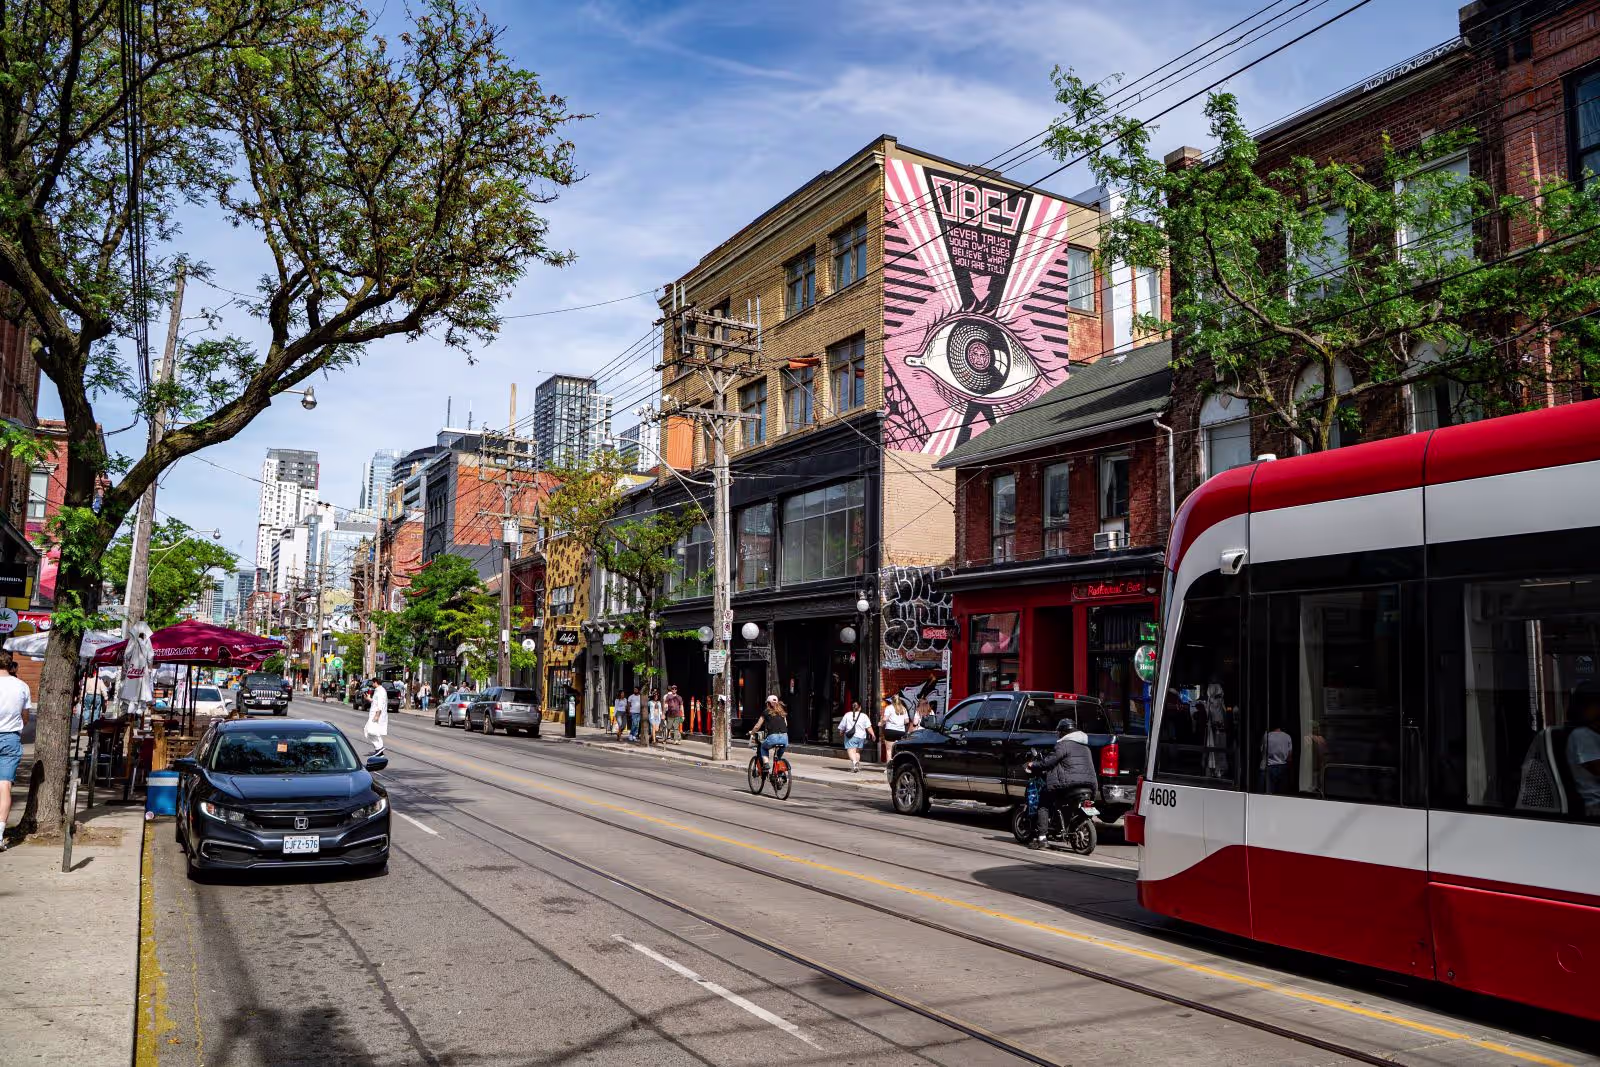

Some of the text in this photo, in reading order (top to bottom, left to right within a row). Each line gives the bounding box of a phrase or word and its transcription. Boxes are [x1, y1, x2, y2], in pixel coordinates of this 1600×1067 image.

[931, 175, 1026, 235] OBEY
[946, 225, 1011, 248] NEVER TRUST
[949, 237, 1010, 257] YOUR OWN EYES
[952, 246, 1007, 265] BELIEVE WHAT
[955, 257, 1005, 274] YOU ARE TOLD
[1149, 787, 1177, 808] 4608
